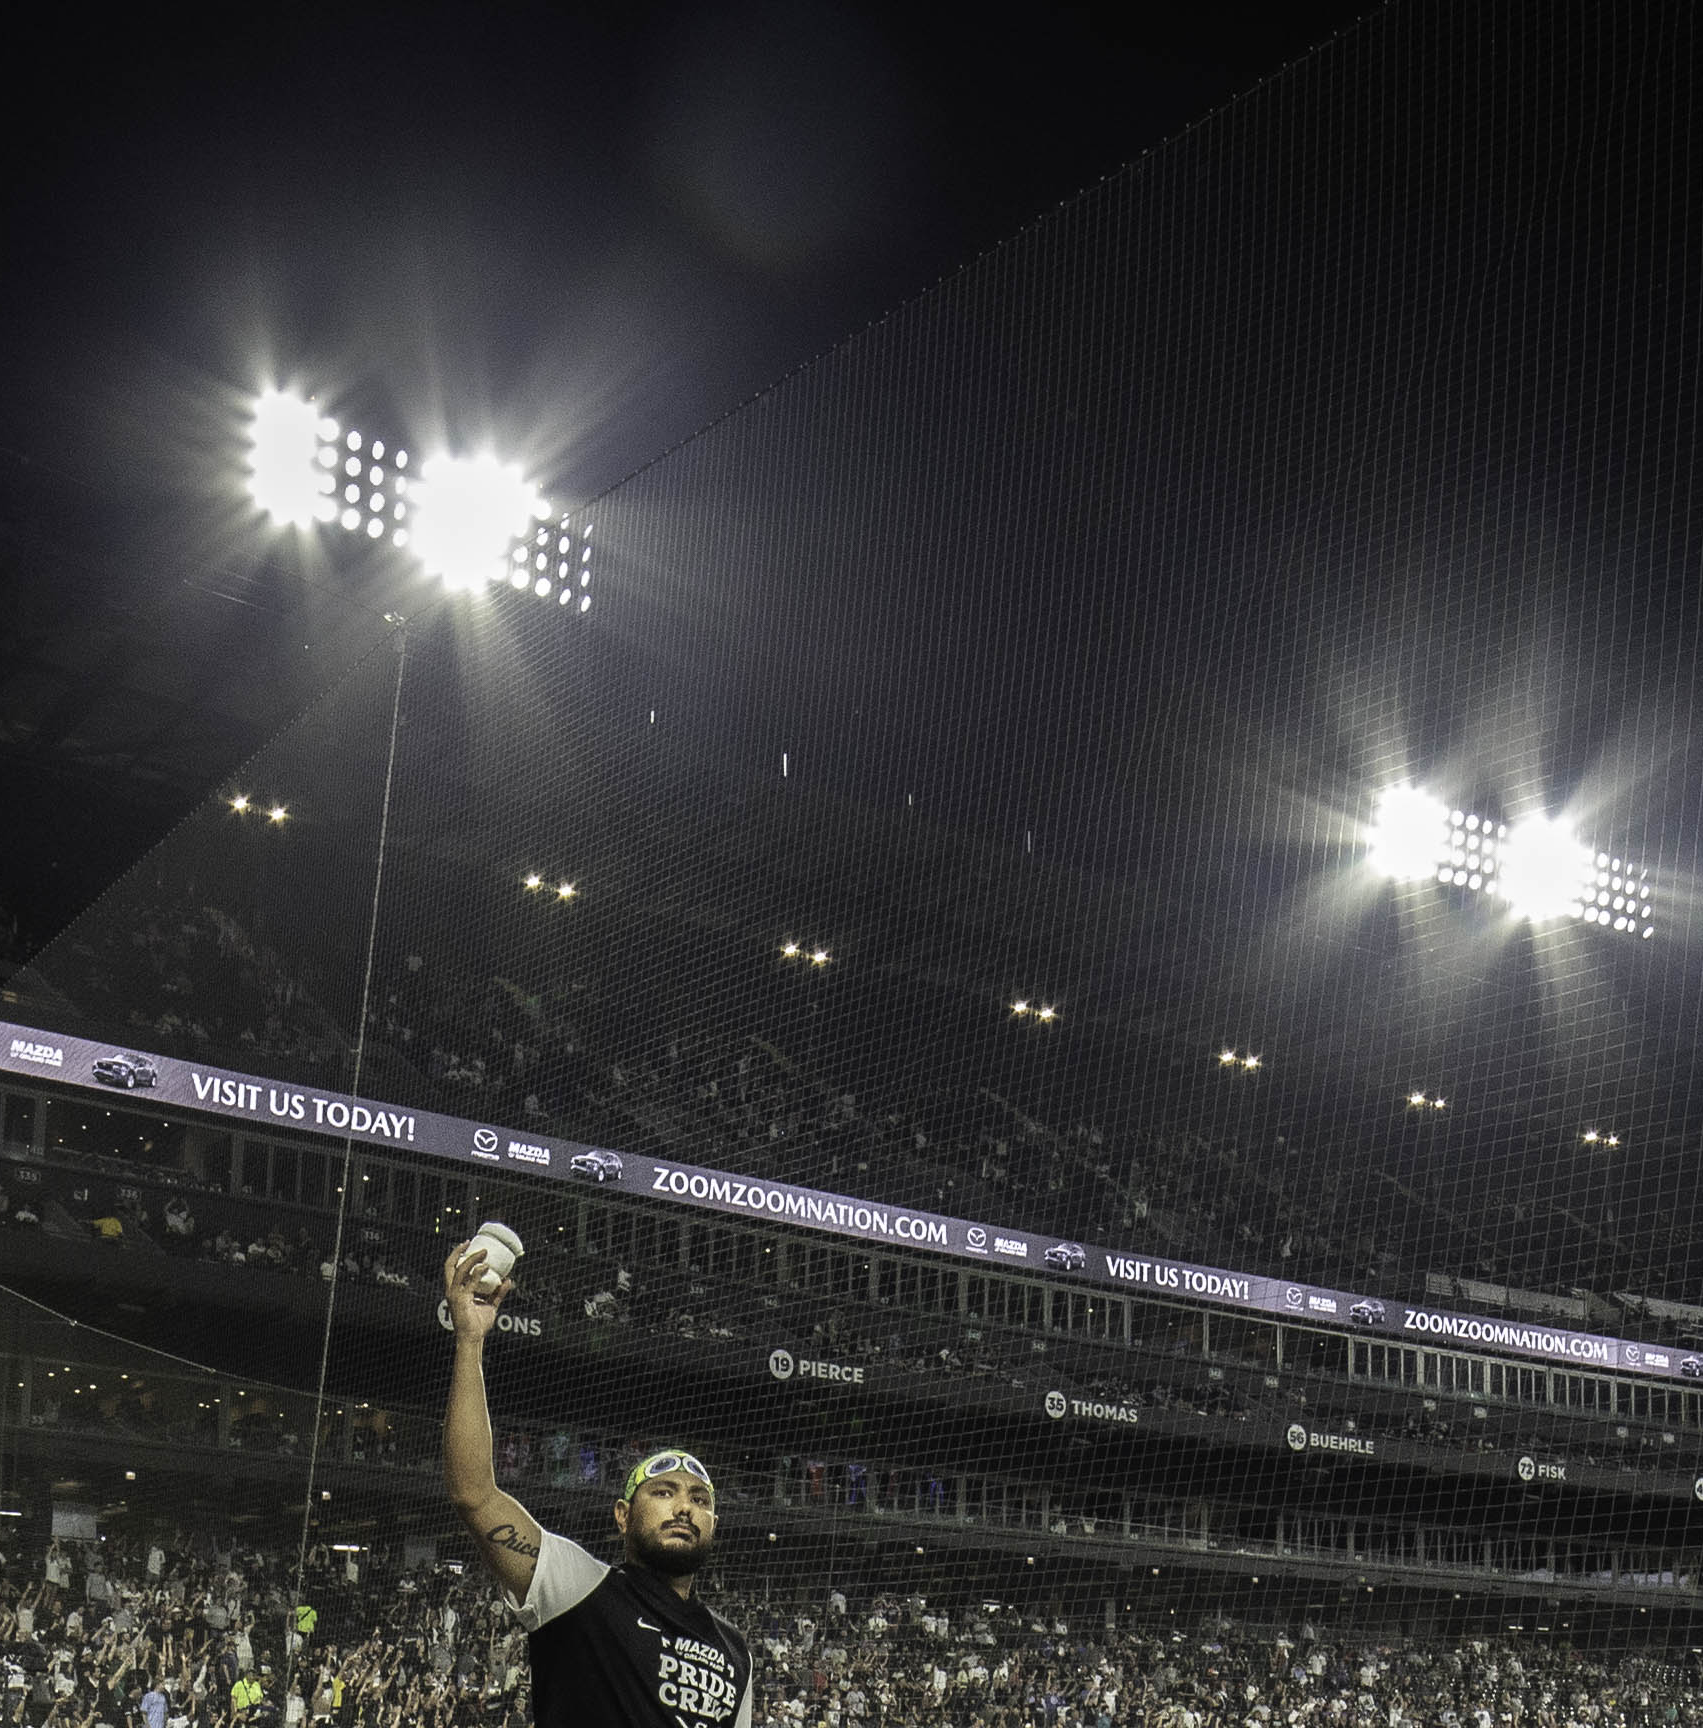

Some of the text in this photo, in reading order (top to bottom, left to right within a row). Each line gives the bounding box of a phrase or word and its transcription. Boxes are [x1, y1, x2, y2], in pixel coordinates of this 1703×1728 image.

[10, 1040, 63, 1060] MAZDA
[191, 1072, 416, 1141] VISIT US TODAY!
[653, 1166, 948, 1244] ZOOMZOOMNATION.COM
[1106, 1256, 1250, 1299] VISIT US TODAY!
[1404, 1310, 1609, 1361] ZOOMZOOMNATION.COM
[773, 1356, 865, 1384] 19 PIERCE
[1046, 1397, 1139, 1424] 35 THOMAS
[1309, 1431, 1376, 1456] BUEHRLE
[1538, 1465, 1566, 1480] FISK
[674, 1637, 725, 1667] MAZDA
[658, 1653, 737, 1709] PRIDE
[658, 1681, 735, 1722] CREW
